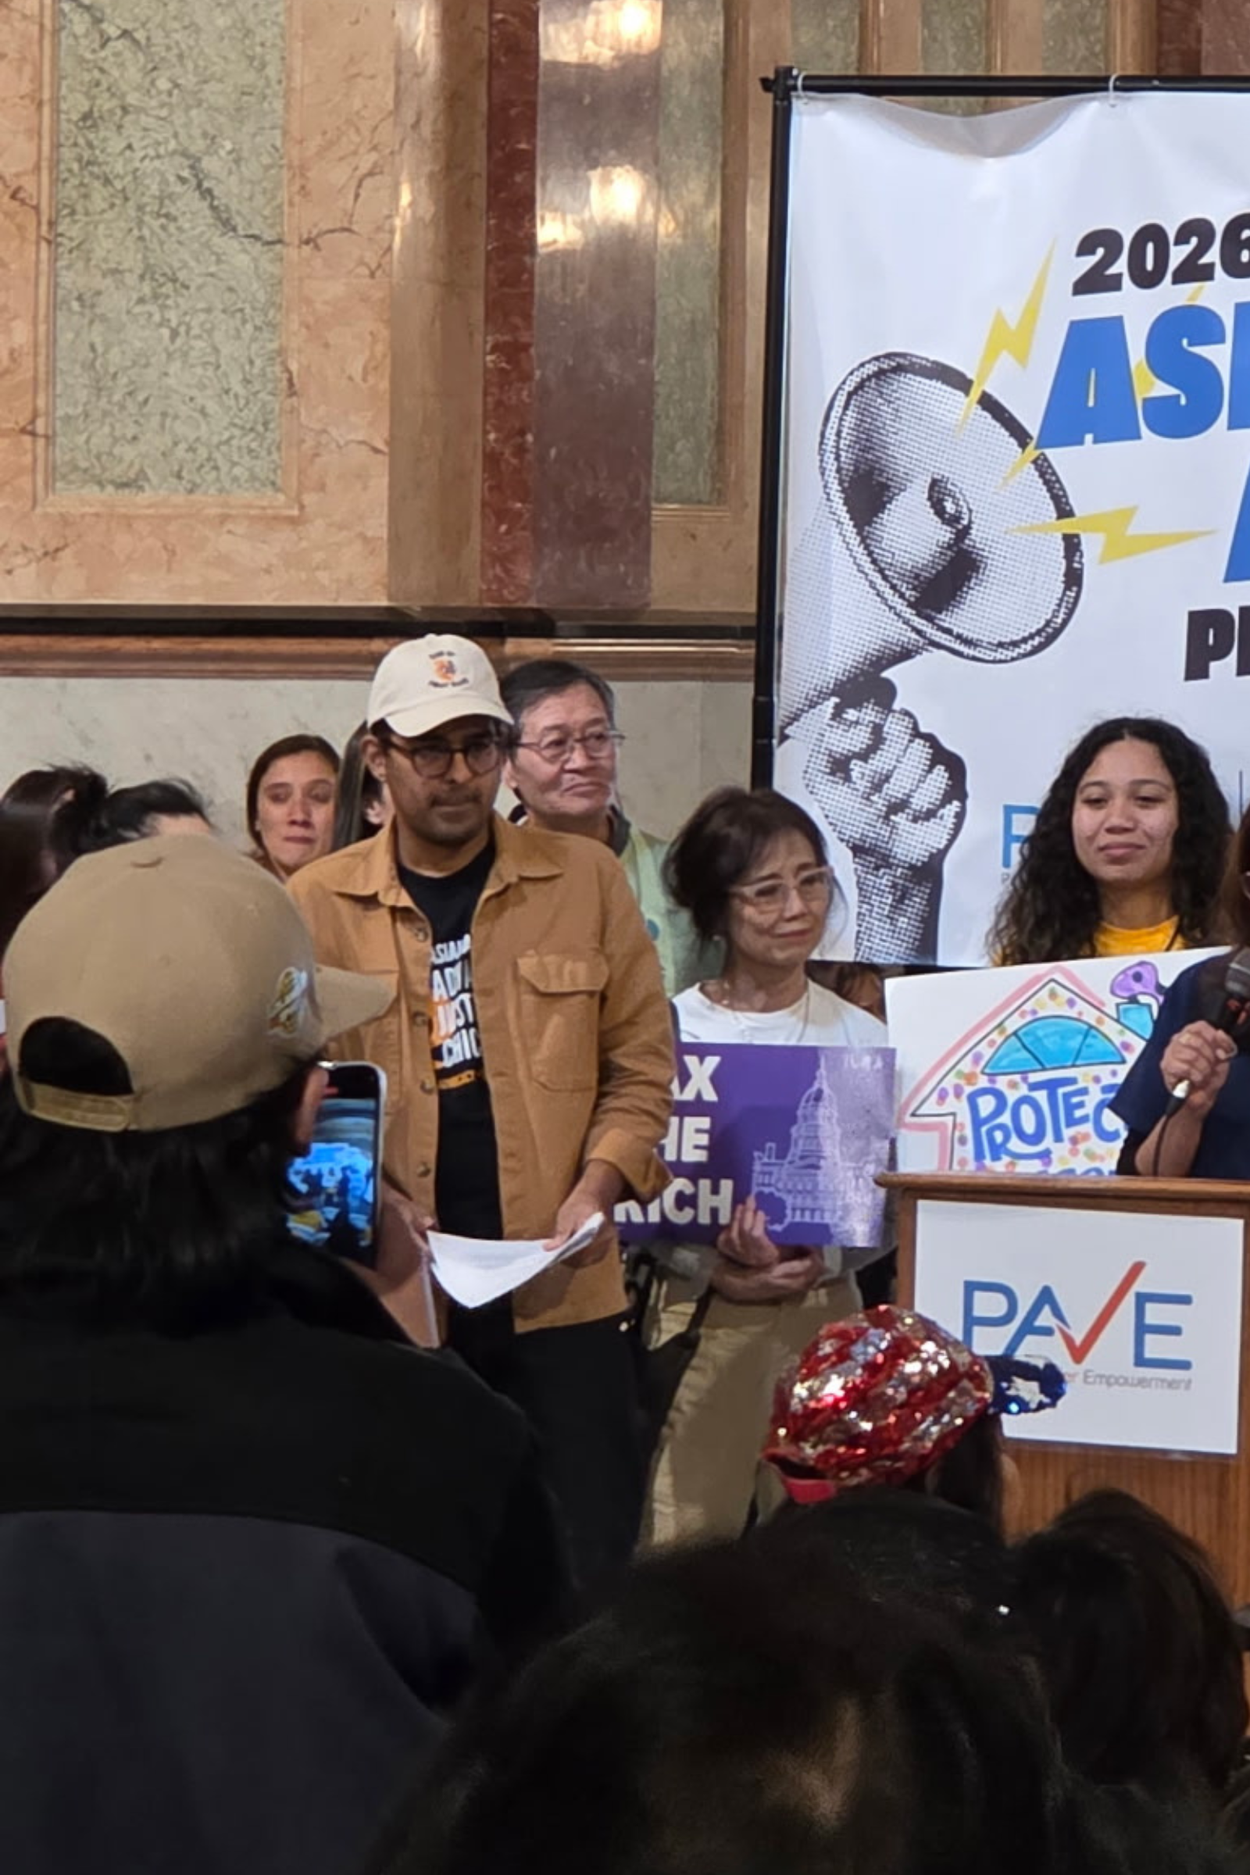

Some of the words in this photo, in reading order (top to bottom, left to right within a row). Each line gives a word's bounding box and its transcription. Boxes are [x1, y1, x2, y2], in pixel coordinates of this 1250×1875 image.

[660, 1116, 711, 1162] HE
[966, 1076, 1129, 1162] PROTEC
[962, 1260, 1194, 1371] PAVE
[1083, 1369, 1193, 1392] Empowerment
